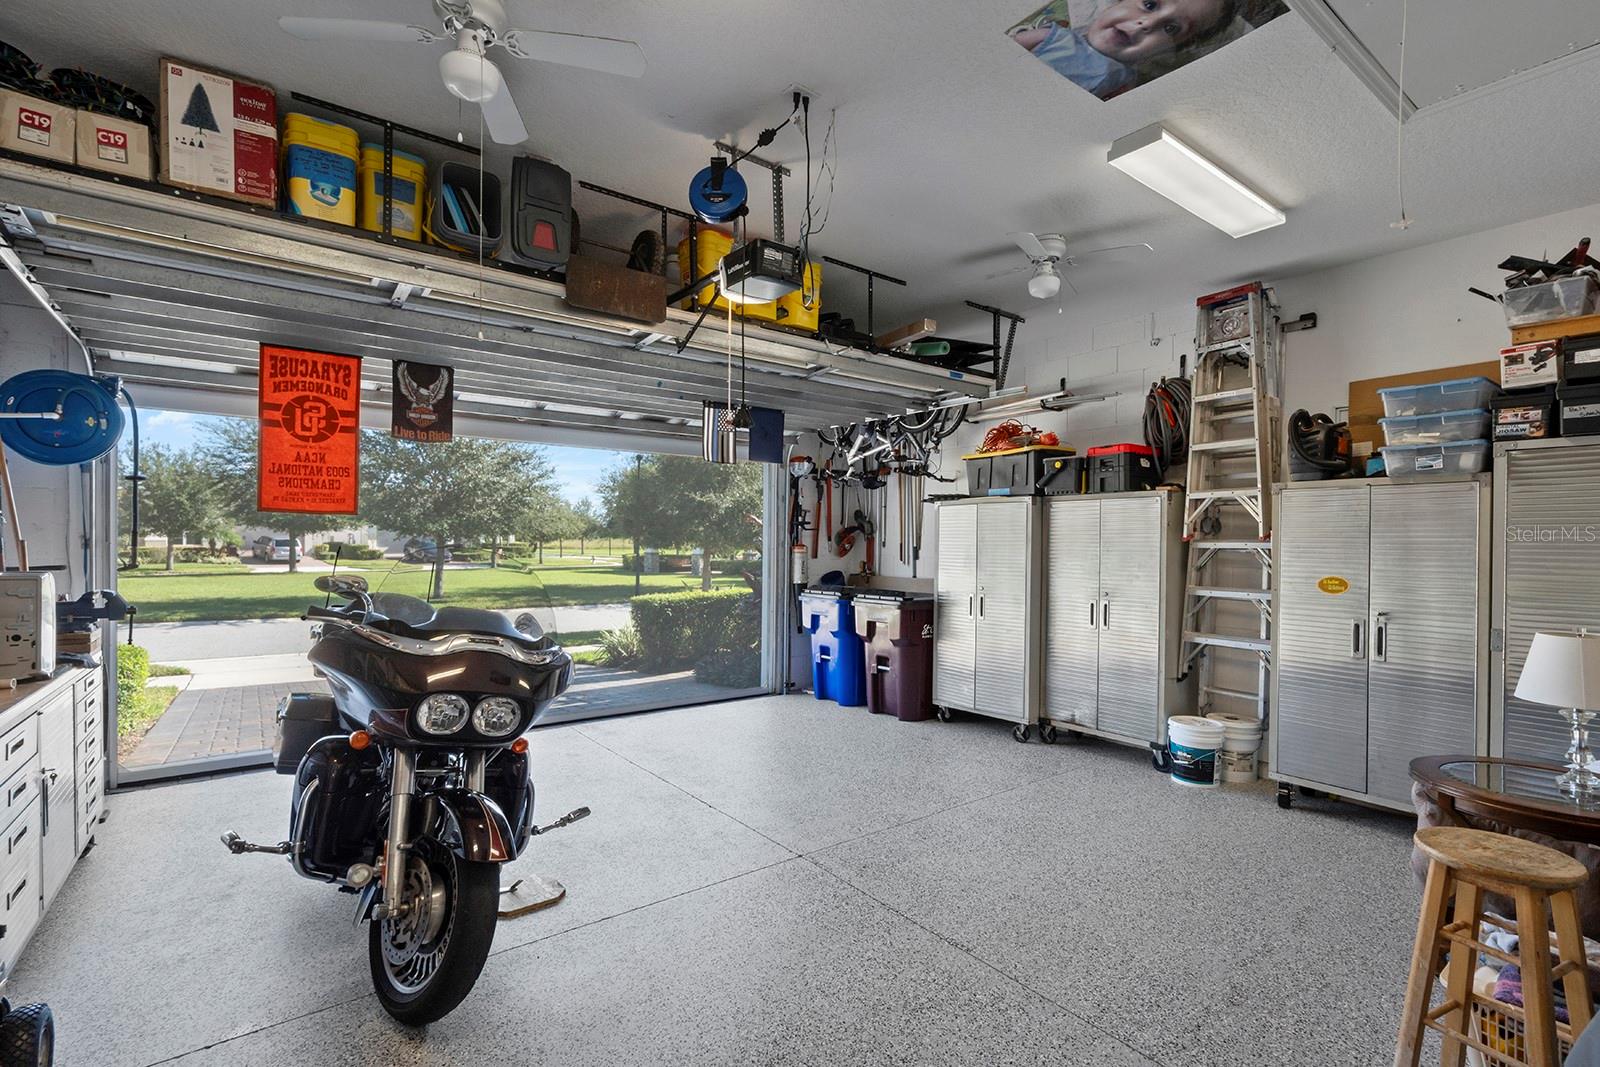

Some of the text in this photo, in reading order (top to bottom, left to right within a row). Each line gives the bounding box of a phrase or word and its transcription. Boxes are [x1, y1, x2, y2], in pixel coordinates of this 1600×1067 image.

[20, 111, 51, 128] C19
[98, 131, 125, 145] C19
[394, 425, 450, 442] Live to Ride
